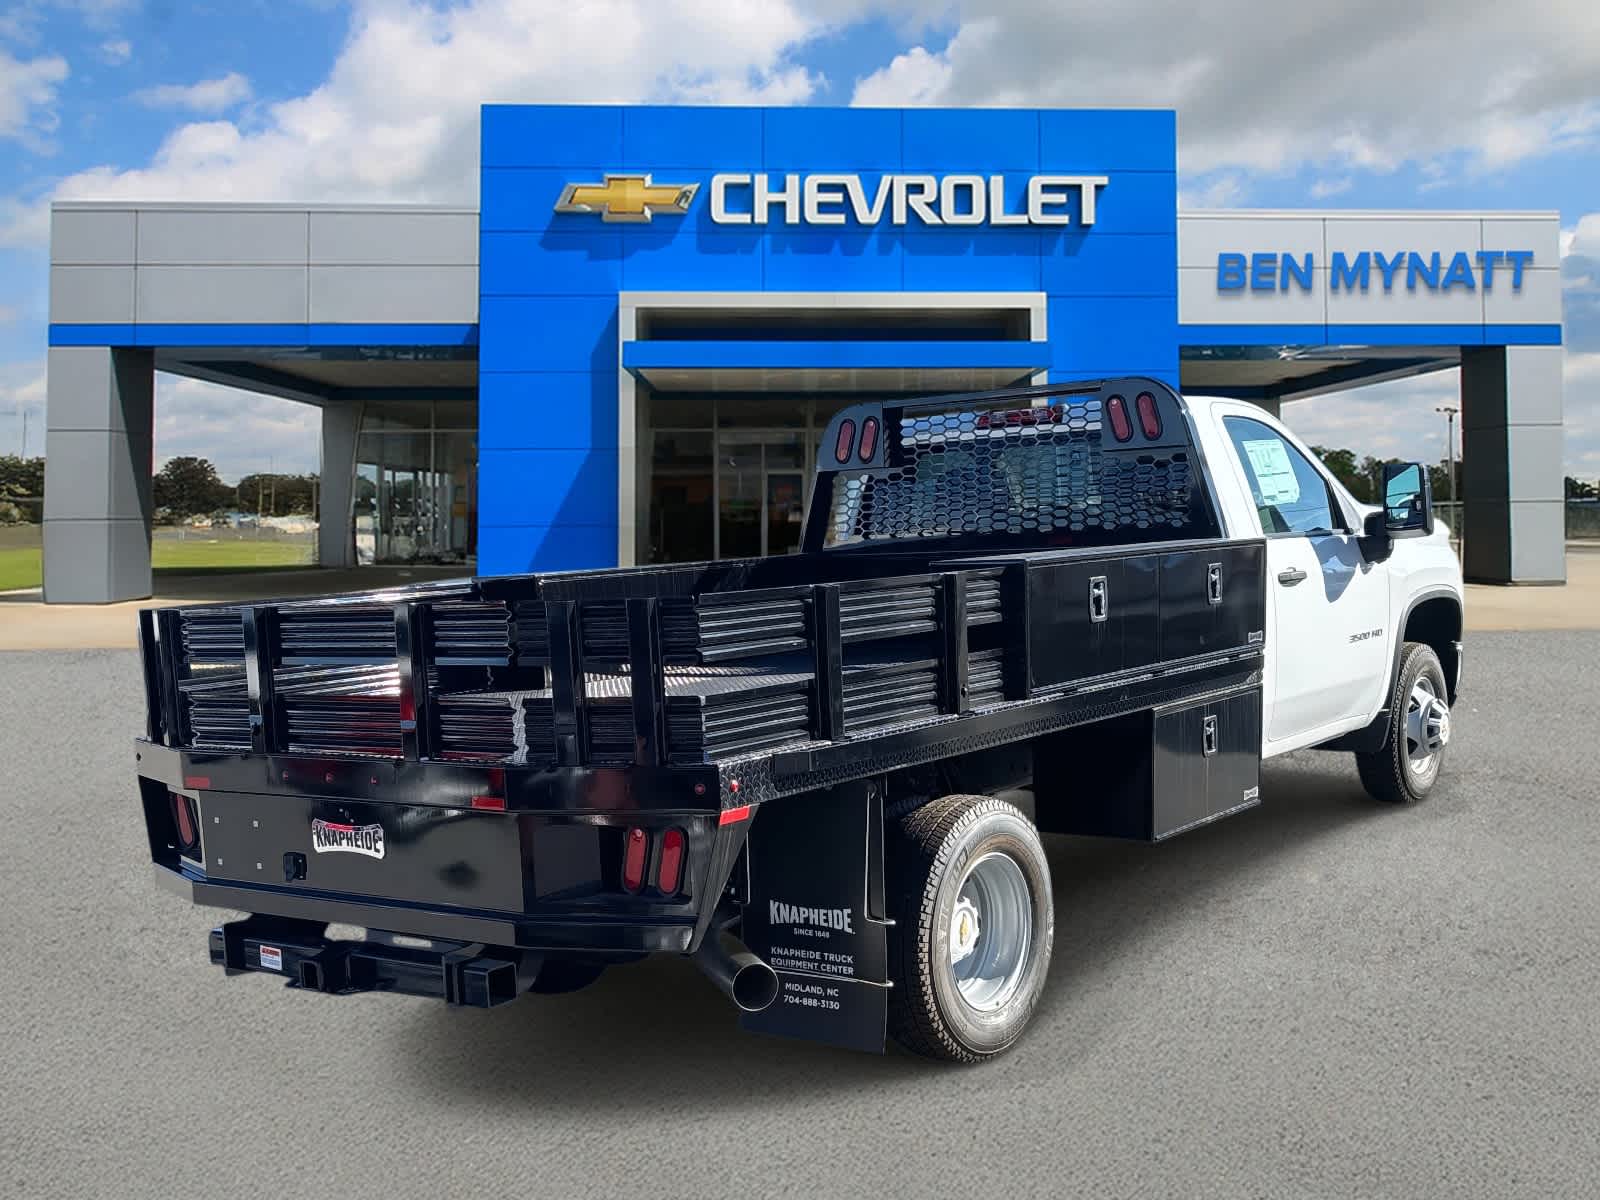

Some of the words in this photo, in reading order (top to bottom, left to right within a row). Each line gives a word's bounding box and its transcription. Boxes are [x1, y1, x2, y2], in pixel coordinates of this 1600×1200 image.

[710, 173, 1109, 225] CHEVROLET
[1217, 252, 1313, 291] BEN
[1330, 250, 1534, 290] MYNATT
[1349, 631, 1370, 643] 3500
[314, 824, 382, 854] KNAPHEIDE
[769, 899, 854, 934] KNAPHEIDE
[793, 927, 814, 937] SINCE
[771, 946, 821, 960] KNAPHEIDE
[823, 952, 854, 964] TRUCK
[771, 957, 819, 970] EQUIPMENT
[820, 963, 854, 976] CENTER
[785, 982, 825, 996] MIDLAND,
[826, 988, 840, 997] NC
[783, 995, 840, 1010] 704-888-3130
